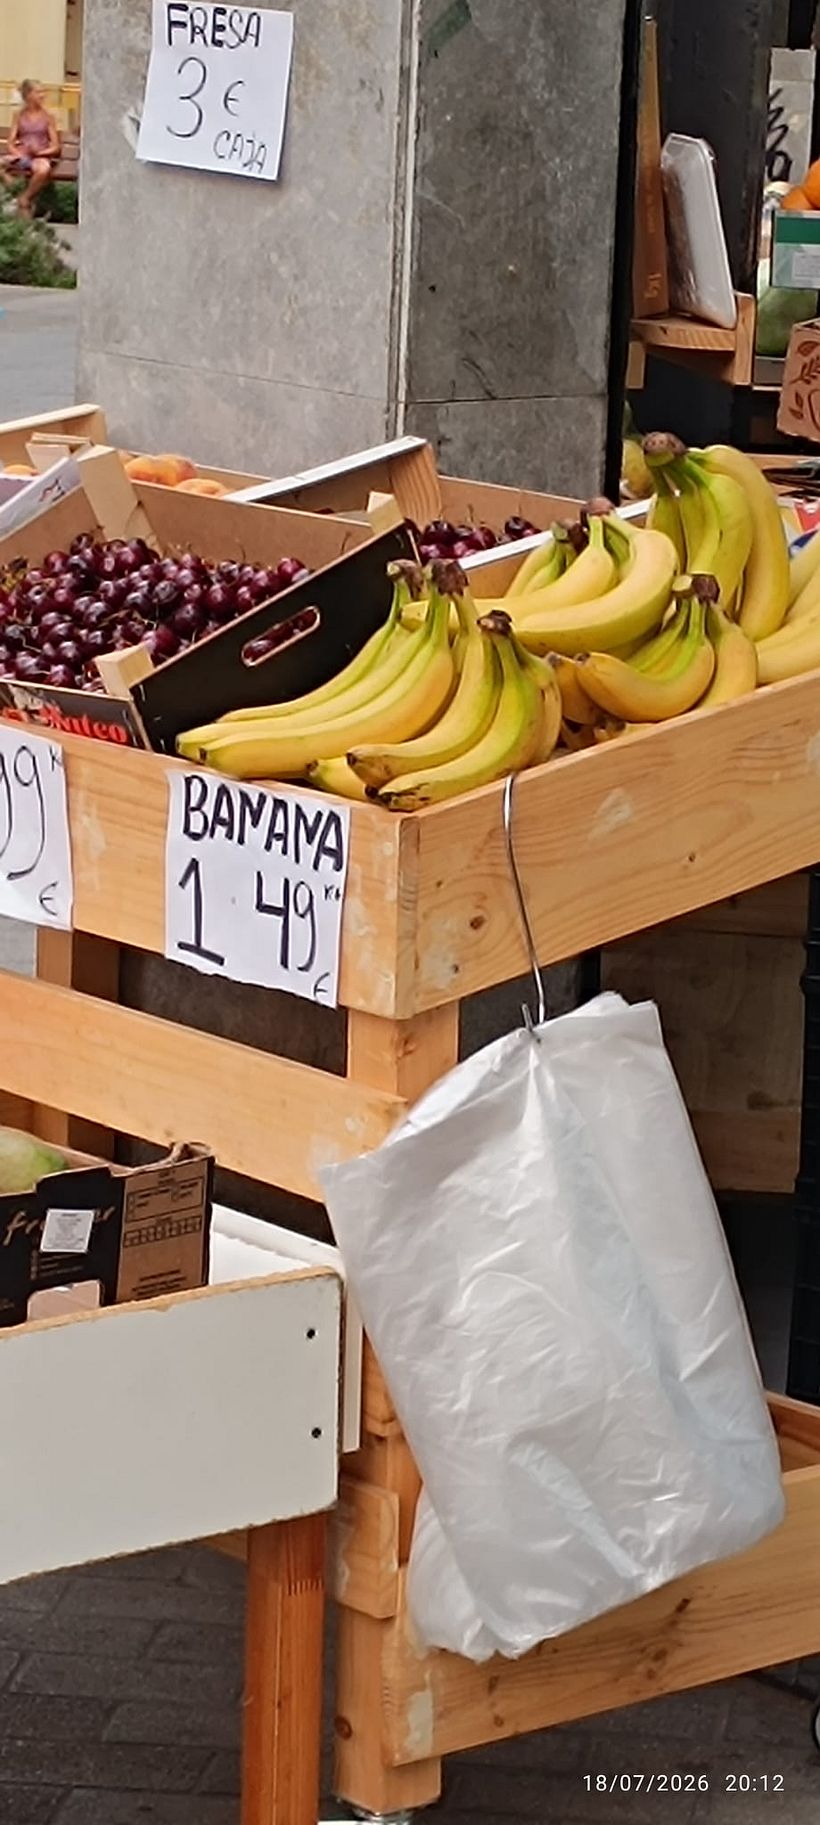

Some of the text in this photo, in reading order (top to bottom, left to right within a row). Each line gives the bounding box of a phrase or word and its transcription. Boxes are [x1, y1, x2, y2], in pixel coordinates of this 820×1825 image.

[166, 3, 261, 49] FRESA
[166, 56, 245, 138] 3 €
[213, 130, 268, 174] CAJA
[182, 774, 344, 873] BANANA
[37, 880, 59, 916] €
